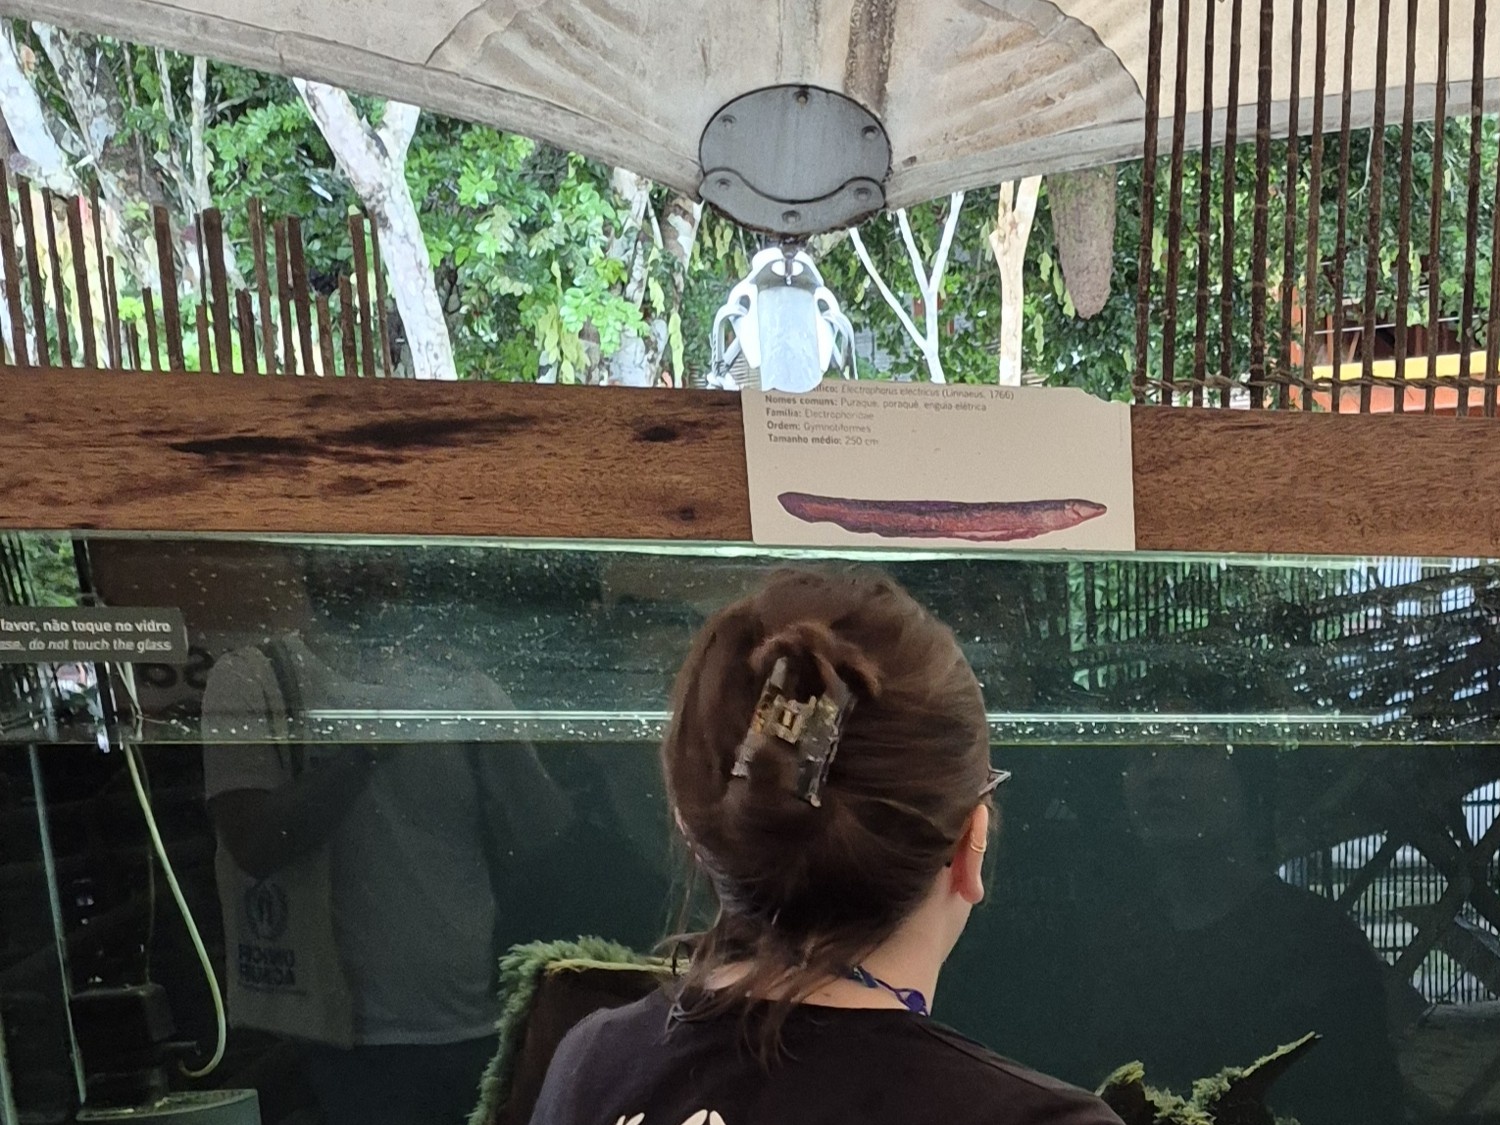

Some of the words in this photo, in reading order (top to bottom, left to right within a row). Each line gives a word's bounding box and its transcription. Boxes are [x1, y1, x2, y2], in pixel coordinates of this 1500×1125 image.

[765, 394, 797, 405] Nomes
[799, 396, 838, 406] comuns:
[924, 402, 952, 411] enguia
[955, 401, 987, 411] elétrica
[766, 407, 802, 418] Família:
[767, 420, 801, 431] Ordem:
[768, 433, 809, 444] Tamanho
[811, 434, 842, 445] médio:
[844, 436, 863, 446] 250
[43, 618, 70, 632] não
[71, 620, 112, 634] toque
[114, 622, 133, 632] no
[135, 620, 171, 632] vidro
[28, 638, 46, 650] do
[47, 639, 70, 650] not
[72, 639, 111, 650] touch
[112, 639, 136, 651] the
[137, 639, 172, 653] glass
